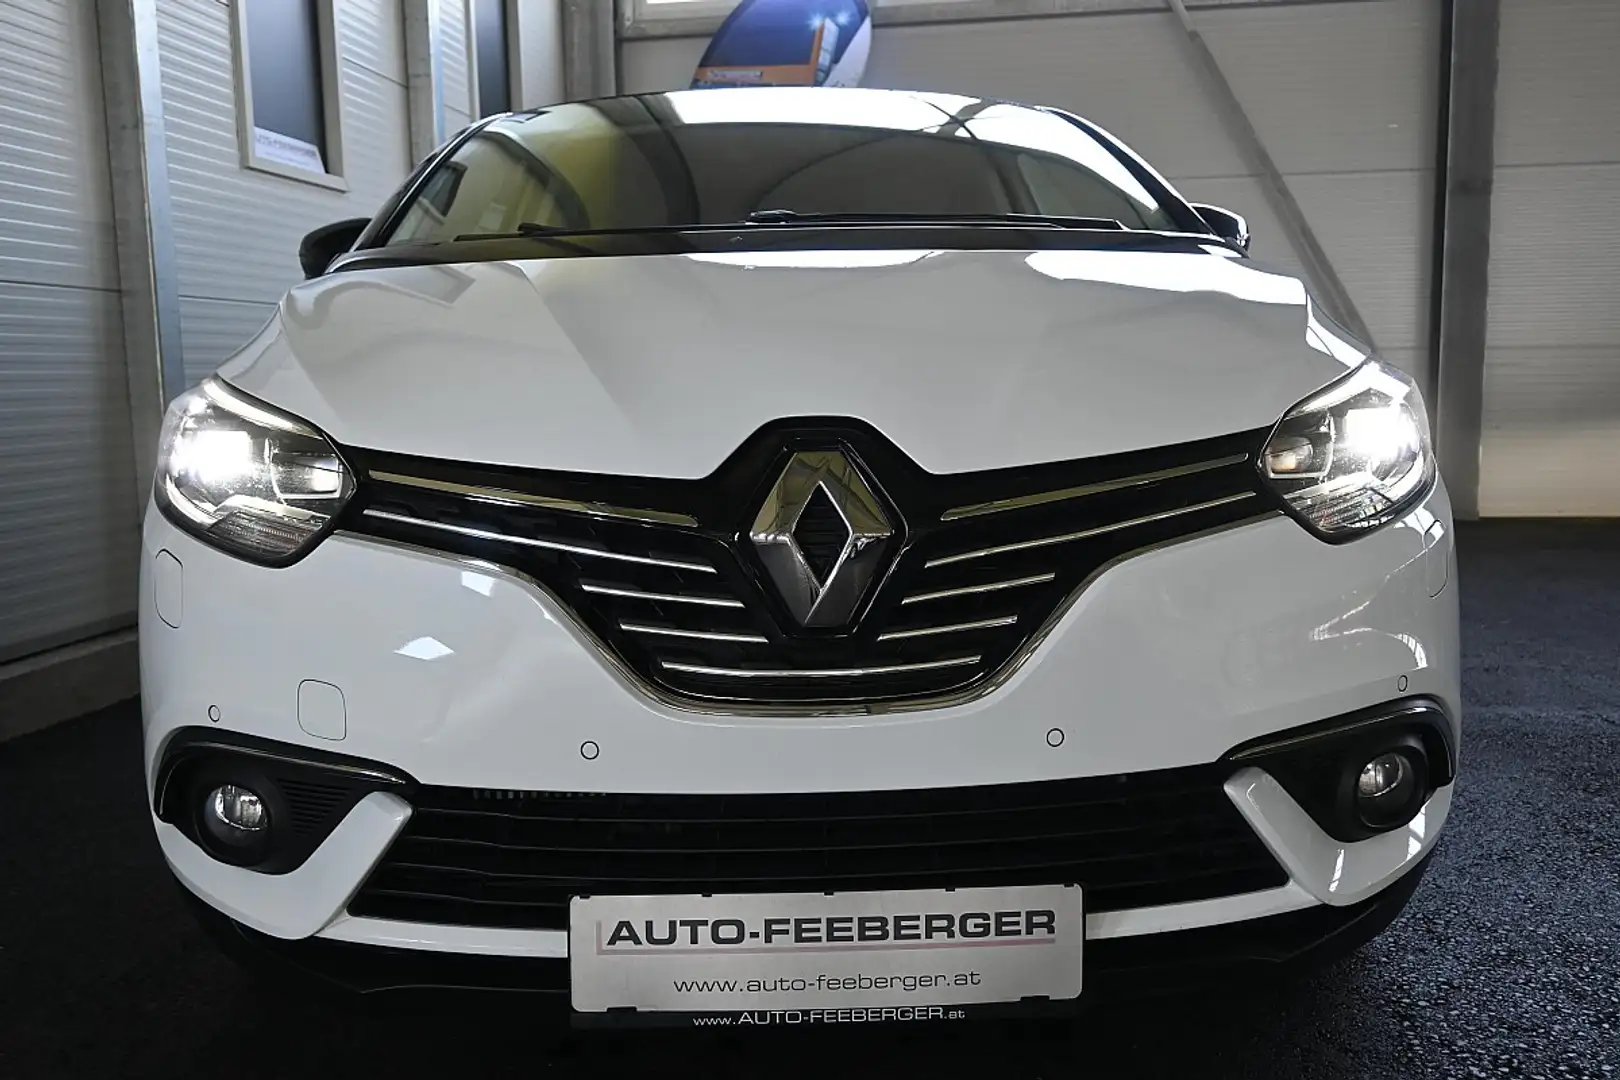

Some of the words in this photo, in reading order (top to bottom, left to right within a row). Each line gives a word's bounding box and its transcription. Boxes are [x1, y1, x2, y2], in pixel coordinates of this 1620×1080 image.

[607, 910, 1056, 945] AUTO-FEEBERGER
[673, 970, 982, 992] www.auto-feeberger.at
[693, 1006, 965, 1026] www.AUTO-FEEBERGER.at
